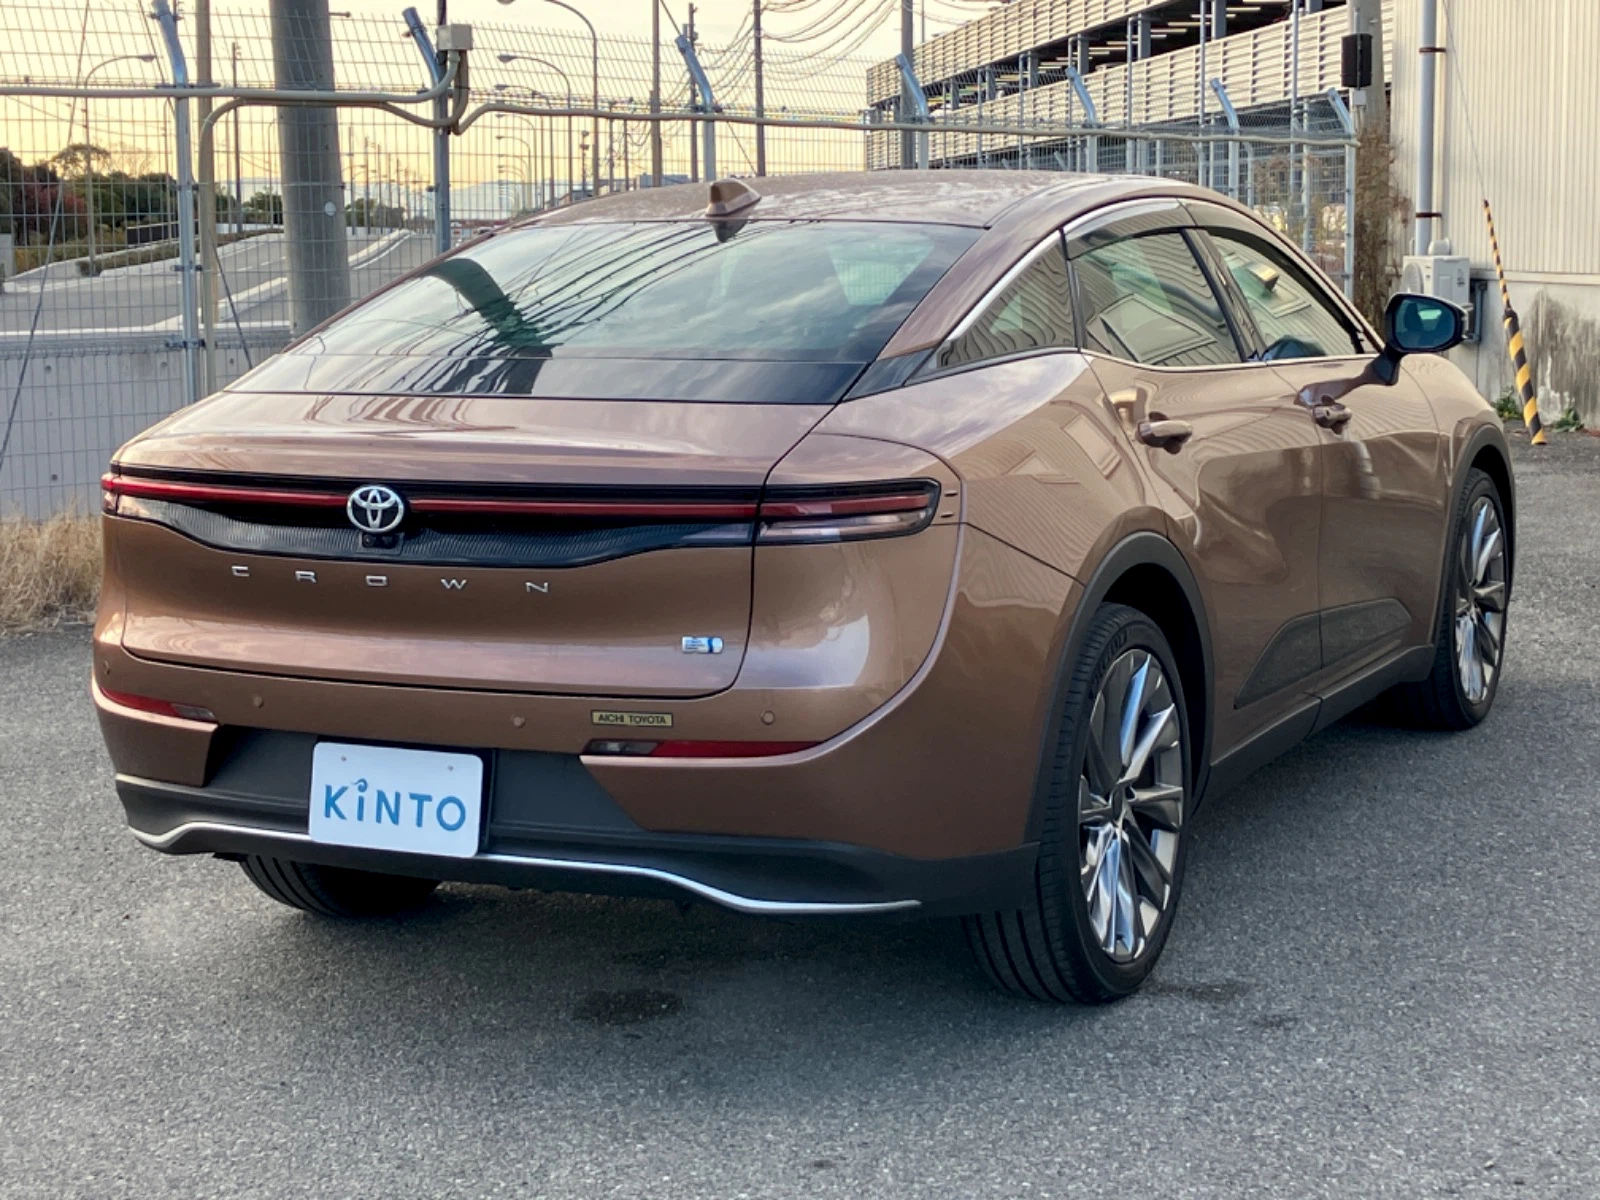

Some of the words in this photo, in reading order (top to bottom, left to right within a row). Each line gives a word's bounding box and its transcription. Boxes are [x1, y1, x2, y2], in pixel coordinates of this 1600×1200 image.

[231, 565, 549, 593] CROWN
[598, 713, 625, 723] AICHI
[628, 715, 667, 725] TOYOTA
